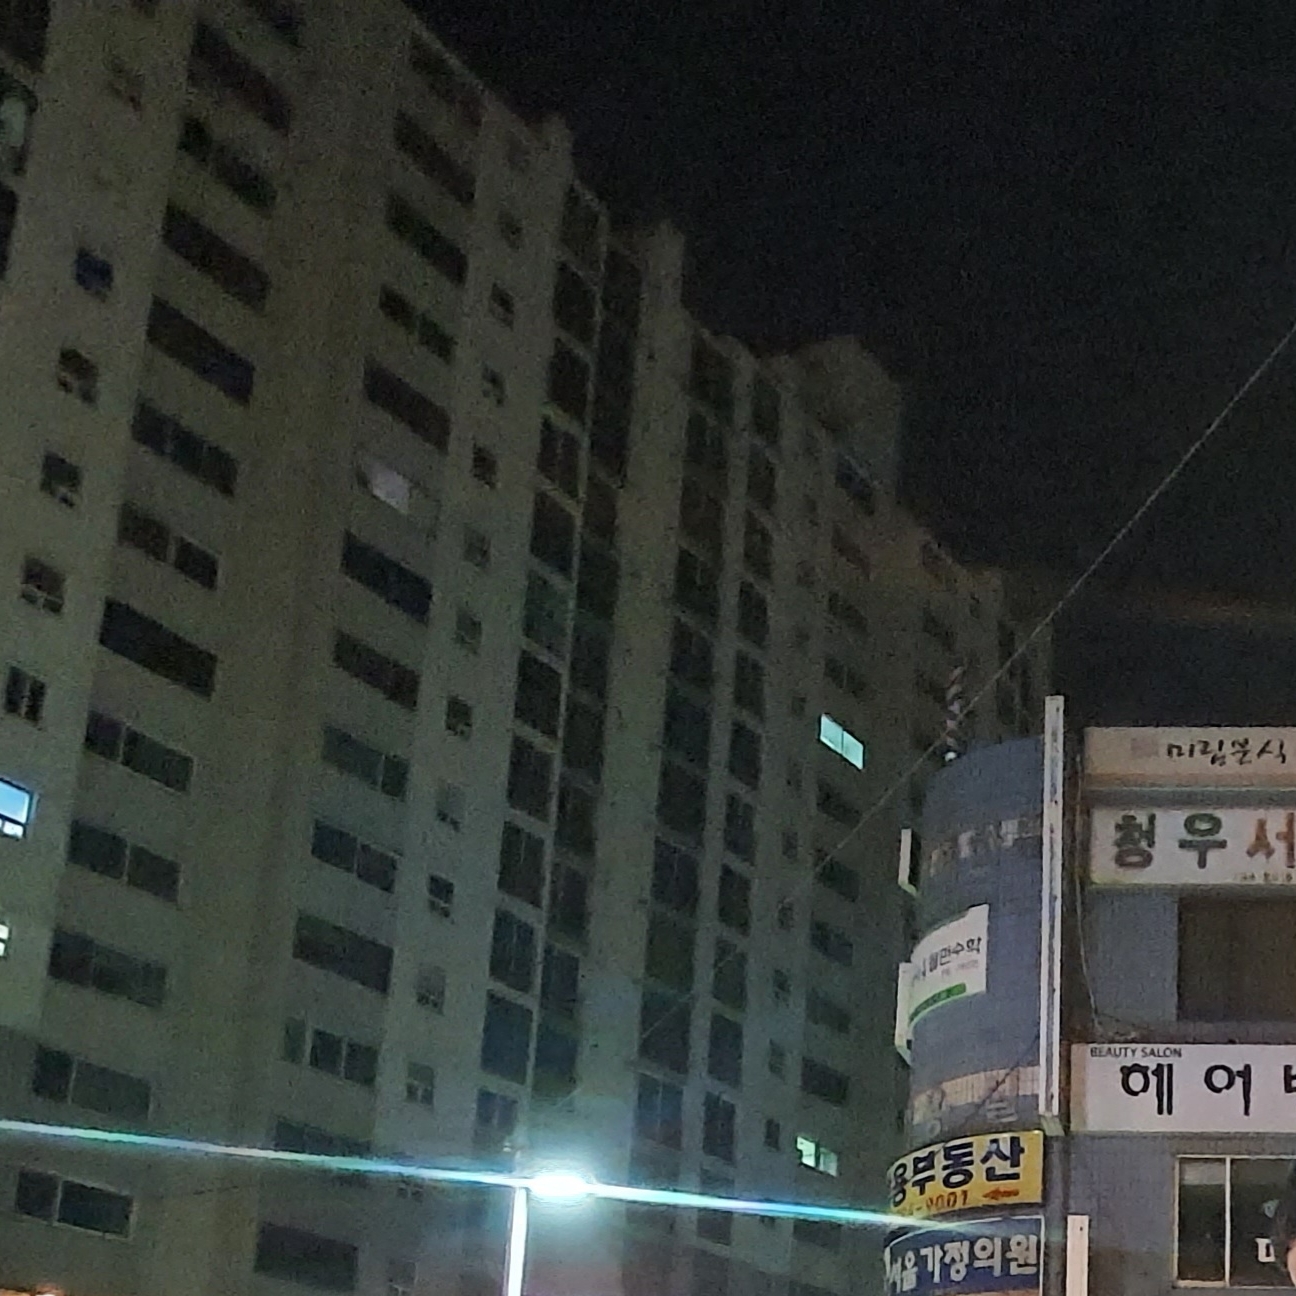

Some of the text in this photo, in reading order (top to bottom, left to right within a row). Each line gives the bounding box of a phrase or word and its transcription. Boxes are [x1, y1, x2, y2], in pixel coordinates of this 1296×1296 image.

[1166, 737, 1287, 767] 미림분식
[1090, 1046, 1182, 1058] BEAUTY SALON
